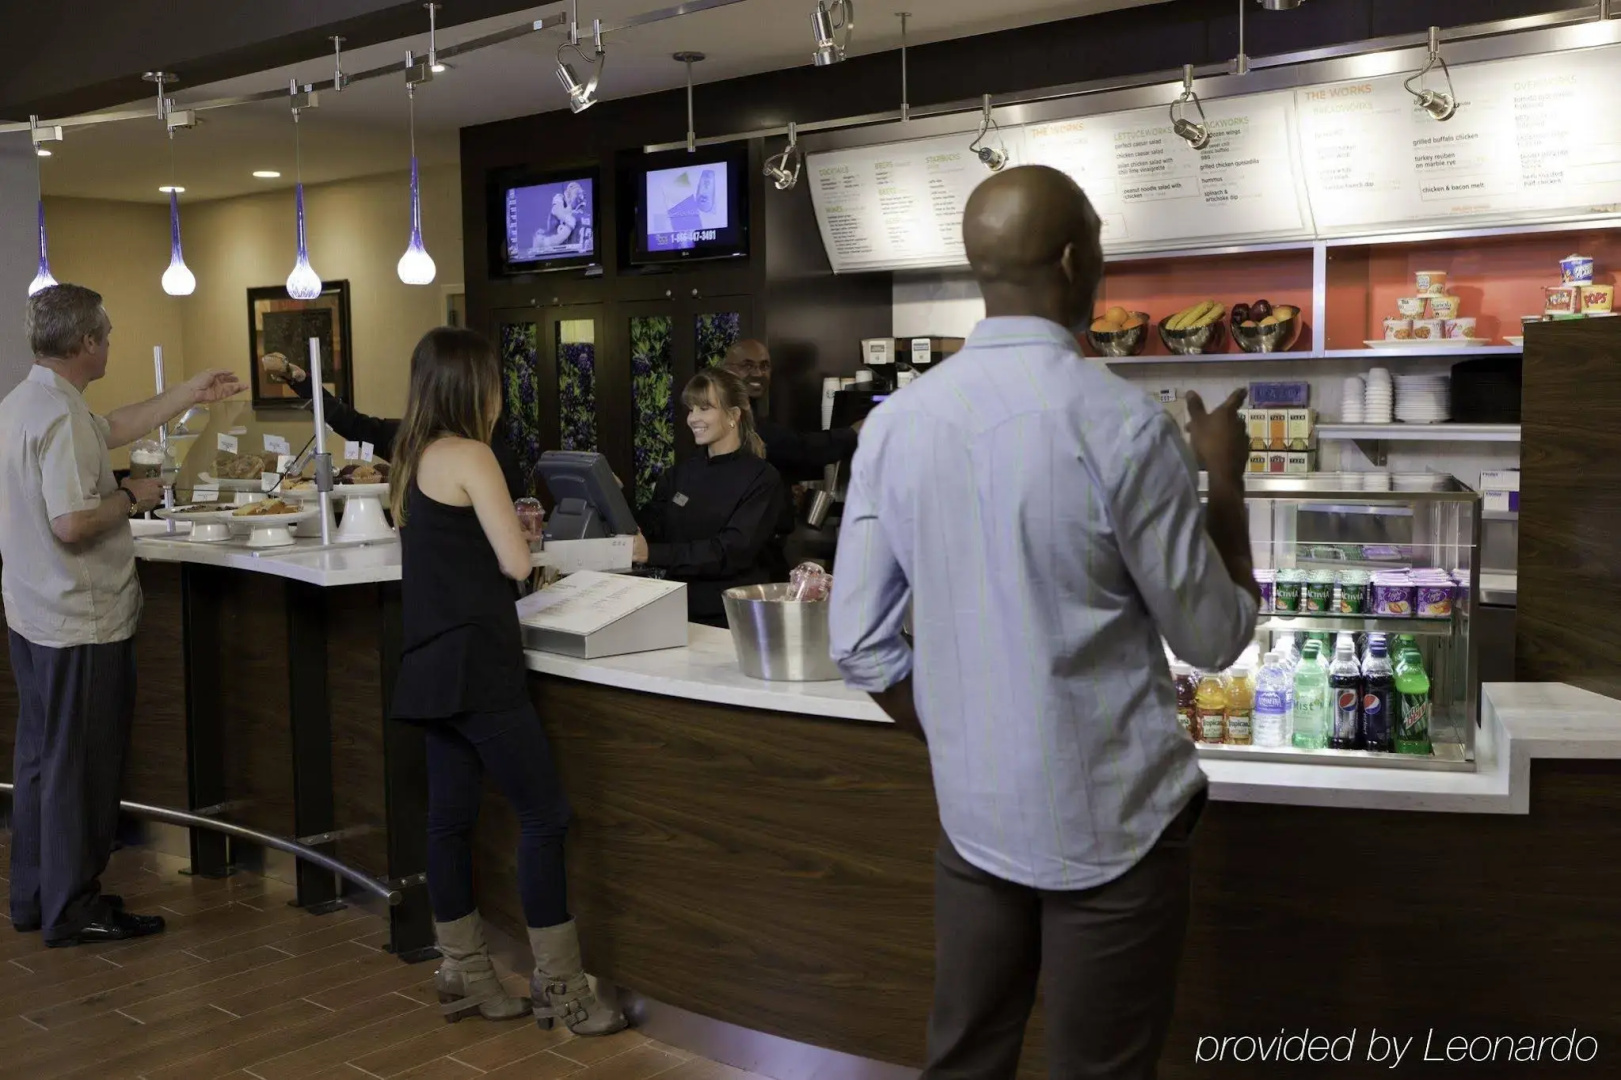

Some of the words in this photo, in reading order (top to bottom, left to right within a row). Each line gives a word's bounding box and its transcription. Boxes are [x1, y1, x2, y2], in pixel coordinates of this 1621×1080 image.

[1304, 90, 1326, 101] THE
[1329, 84, 1372, 98] WORKS
[1114, 127, 1172, 141] LETTUCEWORKS
[1412, 138, 1432, 147] grilled
[1432, 135, 1454, 143] buffalo
[1455, 133, 1479, 141] chicken
[1414, 154, 1434, 162] turkey
[1434, 152, 1456, 160] reuben
[1424, 160, 1445, 168] marble
[1204, 190, 1224, 198] spinach
[1422, 185, 1445, 193] chicken
[1451, 183, 1470, 191] bacon
[1584, 292, 1608, 308] POPS
